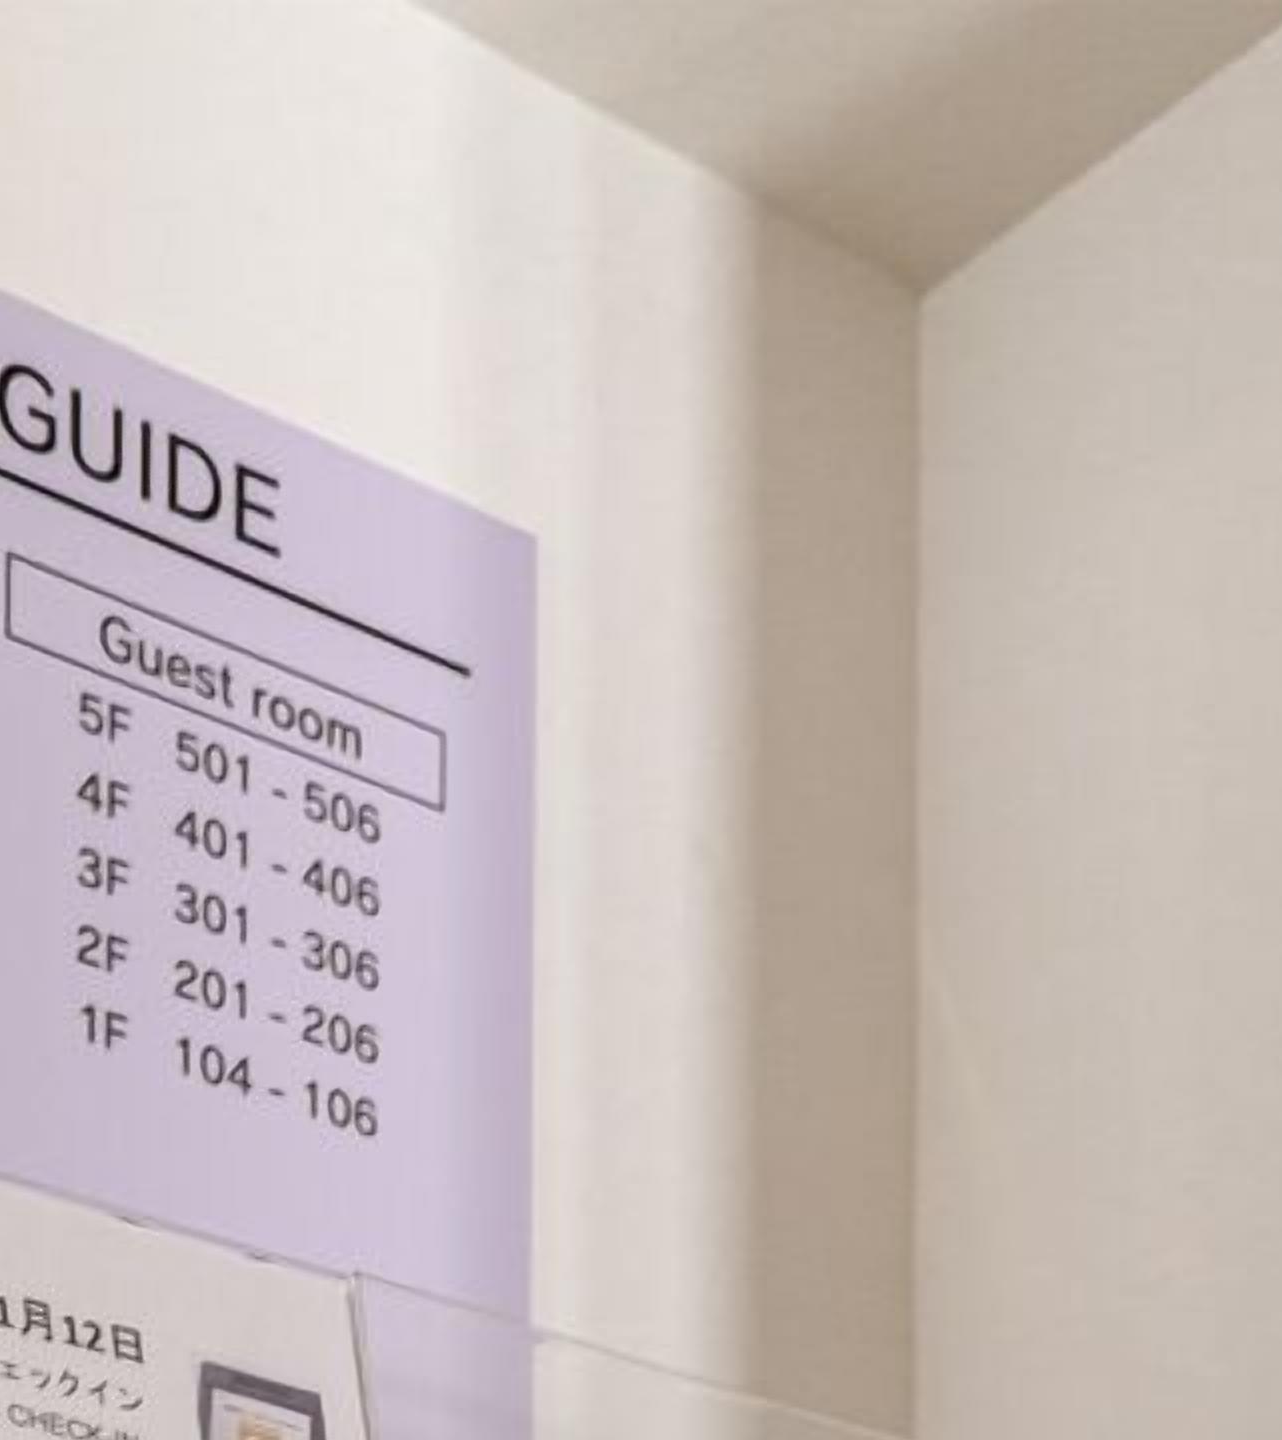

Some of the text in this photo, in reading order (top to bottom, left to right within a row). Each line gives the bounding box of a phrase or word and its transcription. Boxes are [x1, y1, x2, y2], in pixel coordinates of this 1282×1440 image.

[98, 615, 364, 762] Guest room
[78, 694, 132, 744] 5F
[175, 730, 250, 793] 501
[305, 778, 381, 845] 506
[76, 771, 130, 820] 4F
[175, 810, 249, 870] 401
[303, 856, 381, 918] 406
[77, 848, 129, 902] 3F
[175, 884, 249, 945] 301
[303, 930, 380, 991] 306
[77, 925, 129, 978] 2F
[174, 960, 248, 1020] 201
[303, 1005, 380, 1064] 206
[79, 1004, 129, 1050] 1F
[175, 1036, 252, 1096] 104
[304, 1078, 379, 1137] 106
